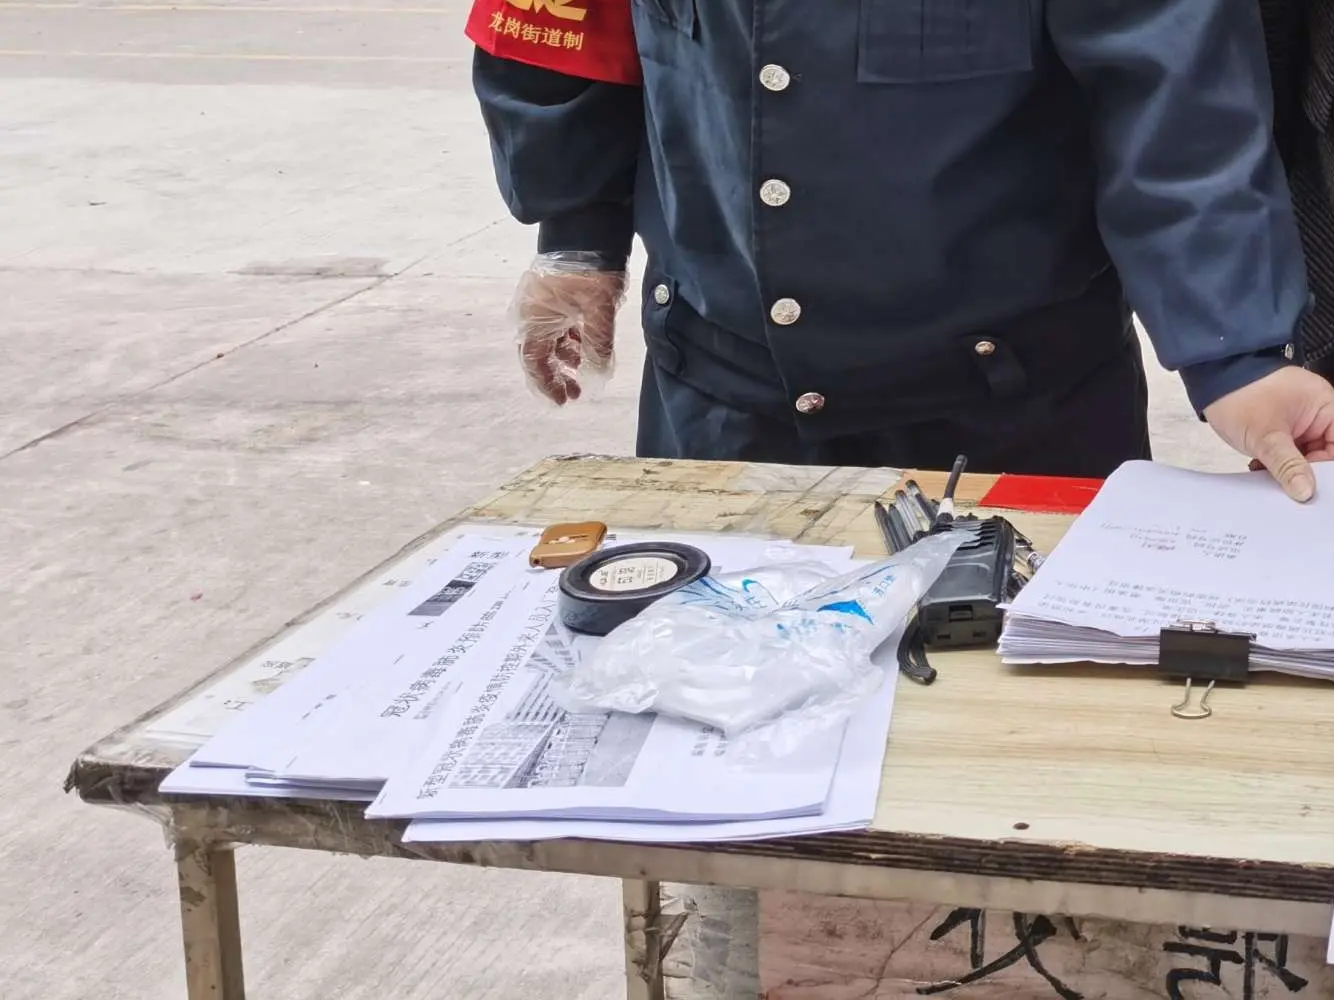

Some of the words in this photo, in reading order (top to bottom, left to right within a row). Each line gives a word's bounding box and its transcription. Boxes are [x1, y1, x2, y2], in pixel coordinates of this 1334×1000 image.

[489, 11, 585, 51] 龙岗街道制
